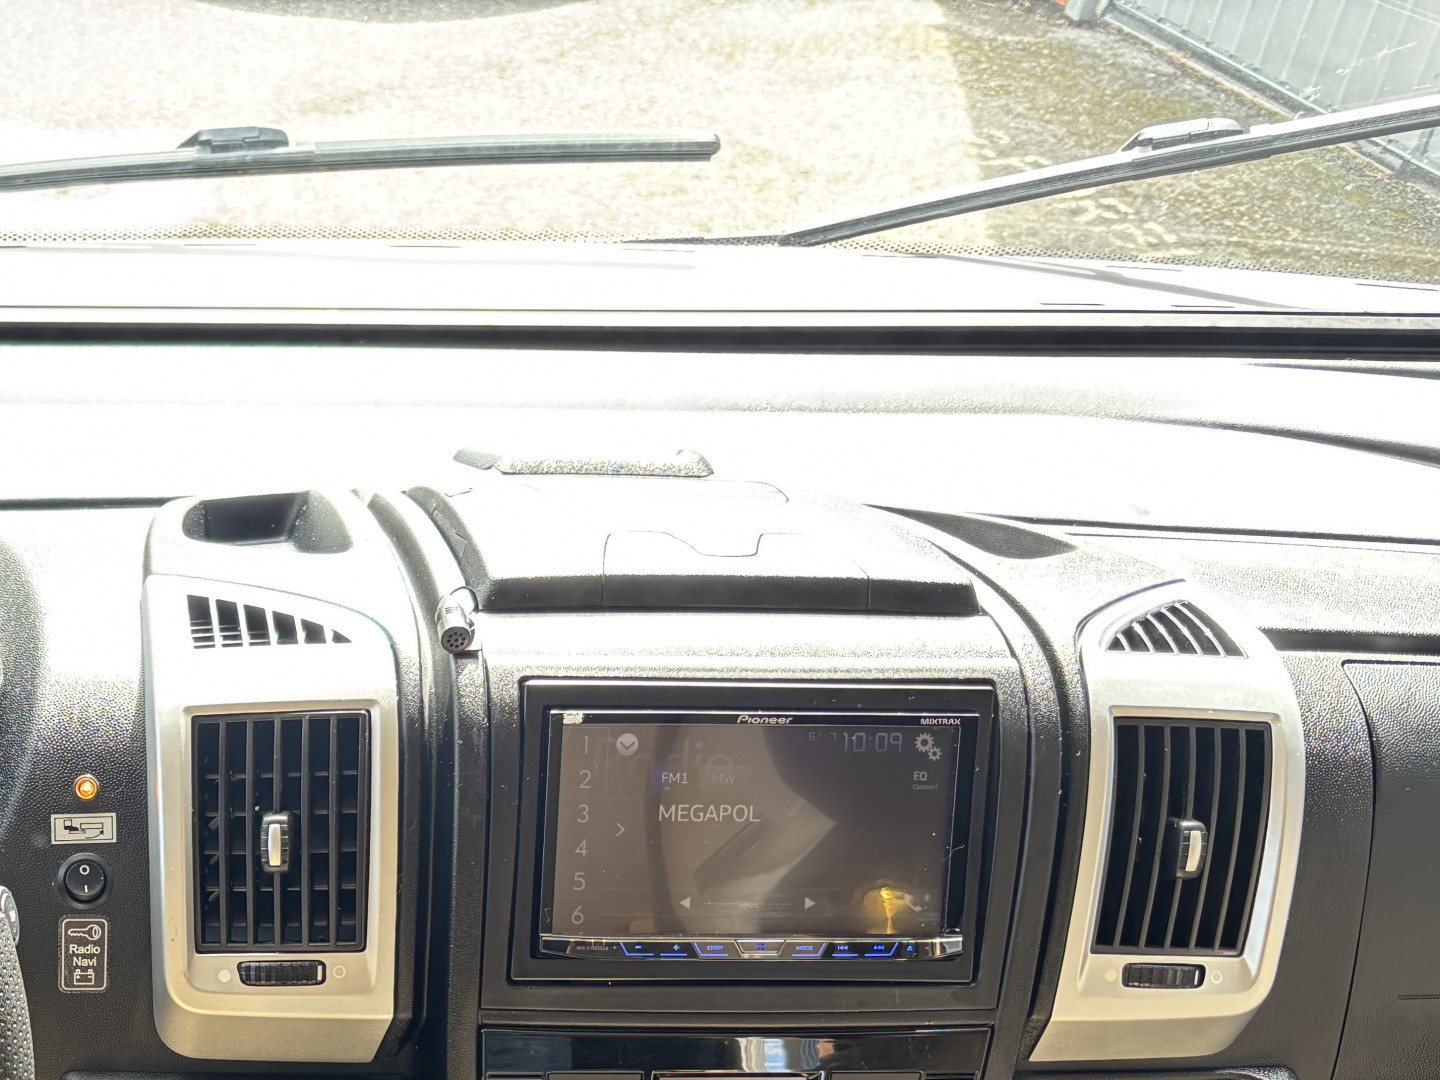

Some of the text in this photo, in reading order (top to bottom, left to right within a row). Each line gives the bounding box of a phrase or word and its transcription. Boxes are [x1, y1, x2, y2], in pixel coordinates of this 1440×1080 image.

[736, 714, 794, 725] Pioneer
[920, 717, 961, 726] MIXTRAX
[582, 735, 590, 756] 1
[843, 732, 903, 752] 10:09
[578, 769, 592, 789] 2
[661, 772, 689, 785] FM1
[711, 772, 736, 784] MW
[913, 771, 928, 782] EQ
[577, 804, 590, 824] 3
[658, 804, 761, 822] MEGAPOL
[575, 839, 588, 857] 4
[572, 872, 586, 891] 5
[571, 906, 584, 925] 6
[69, 944, 101, 955] Radio
[72, 956, 97, 967] Navi
